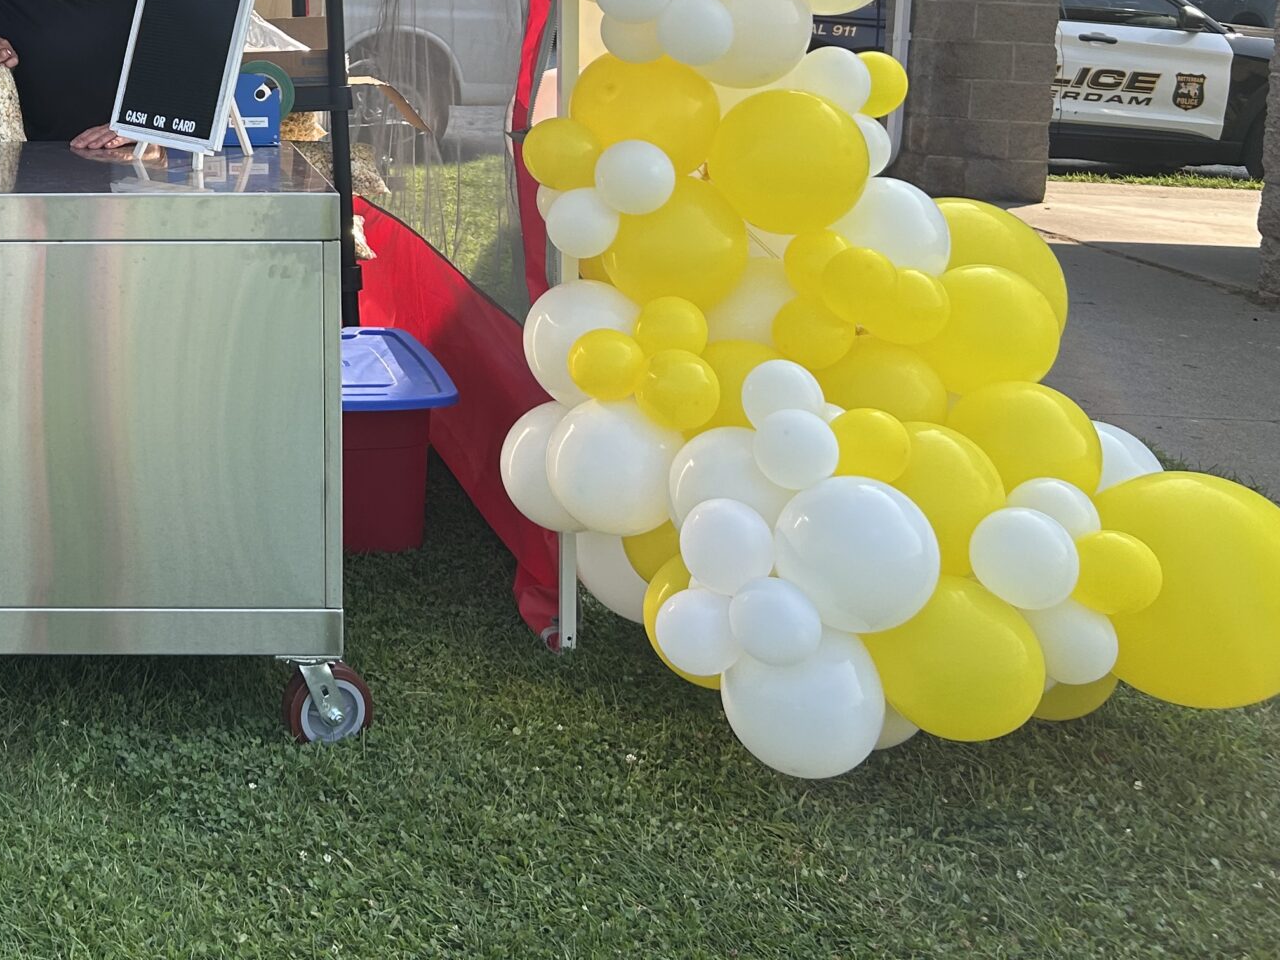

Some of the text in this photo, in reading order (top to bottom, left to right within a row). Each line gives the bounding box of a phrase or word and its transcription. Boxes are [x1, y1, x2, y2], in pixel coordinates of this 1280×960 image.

[832, 25, 857, 37] 911
[1176, 97, 1199, 106] POLICE
[125, 110, 196, 133] CASH OR CARD
